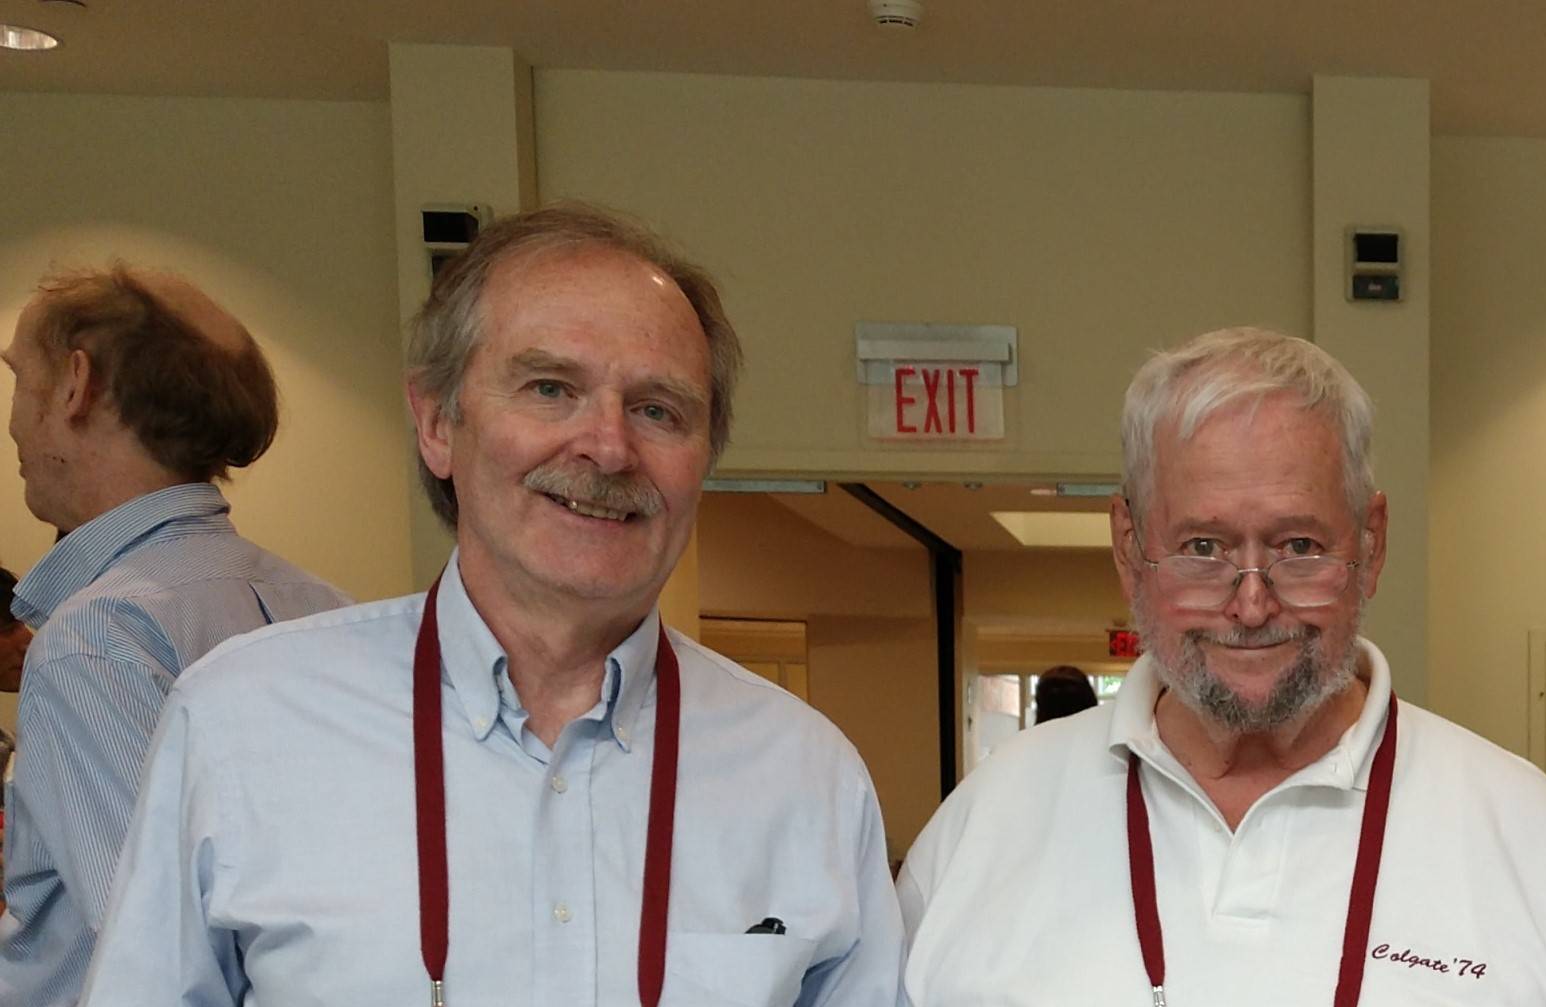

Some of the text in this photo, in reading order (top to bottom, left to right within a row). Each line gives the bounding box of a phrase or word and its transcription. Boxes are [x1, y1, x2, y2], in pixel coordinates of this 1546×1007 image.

[895, 367, 979, 434] EXIT
[1371, 943, 1487, 979] Colgate '74
